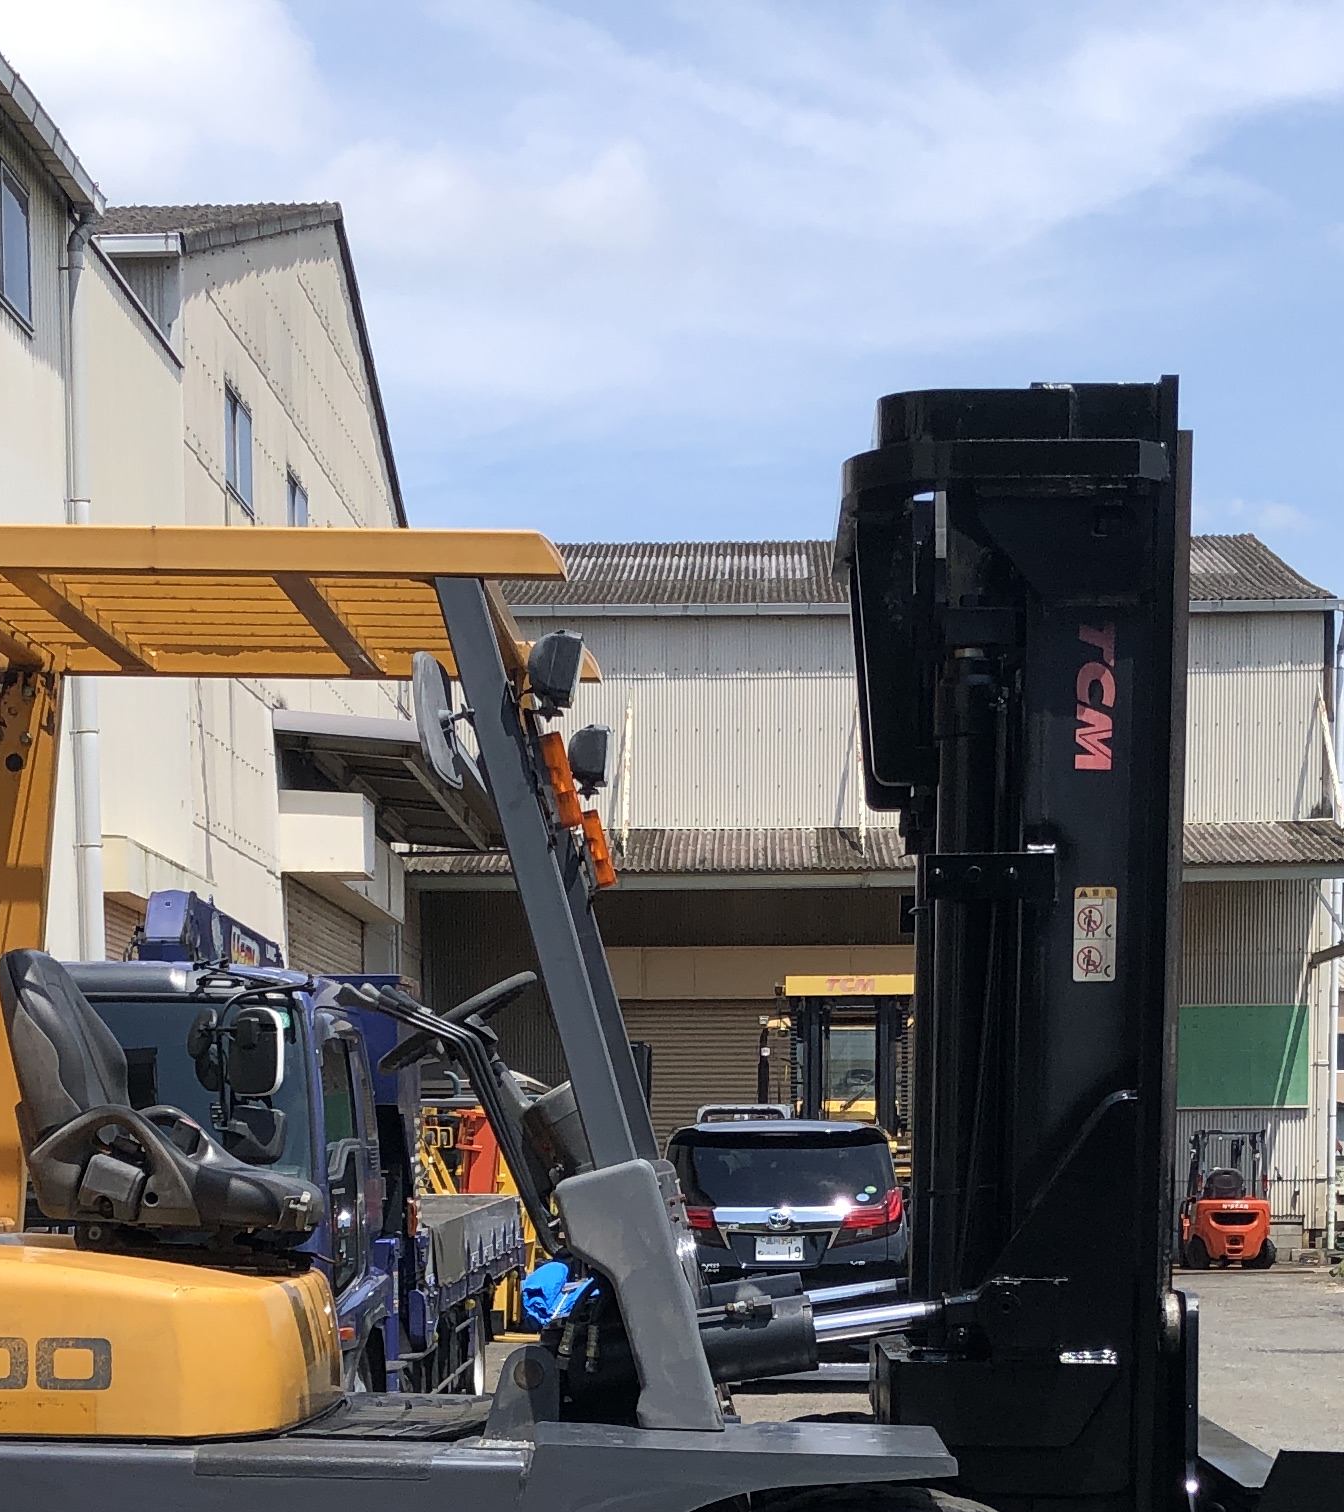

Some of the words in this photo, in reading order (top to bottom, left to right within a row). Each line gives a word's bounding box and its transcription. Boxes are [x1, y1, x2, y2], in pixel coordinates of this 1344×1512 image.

[1075, 622, 1116, 770] TCM
[825, 978, 875, 992] TCM
[788, 1246, 801, 1259] 19
